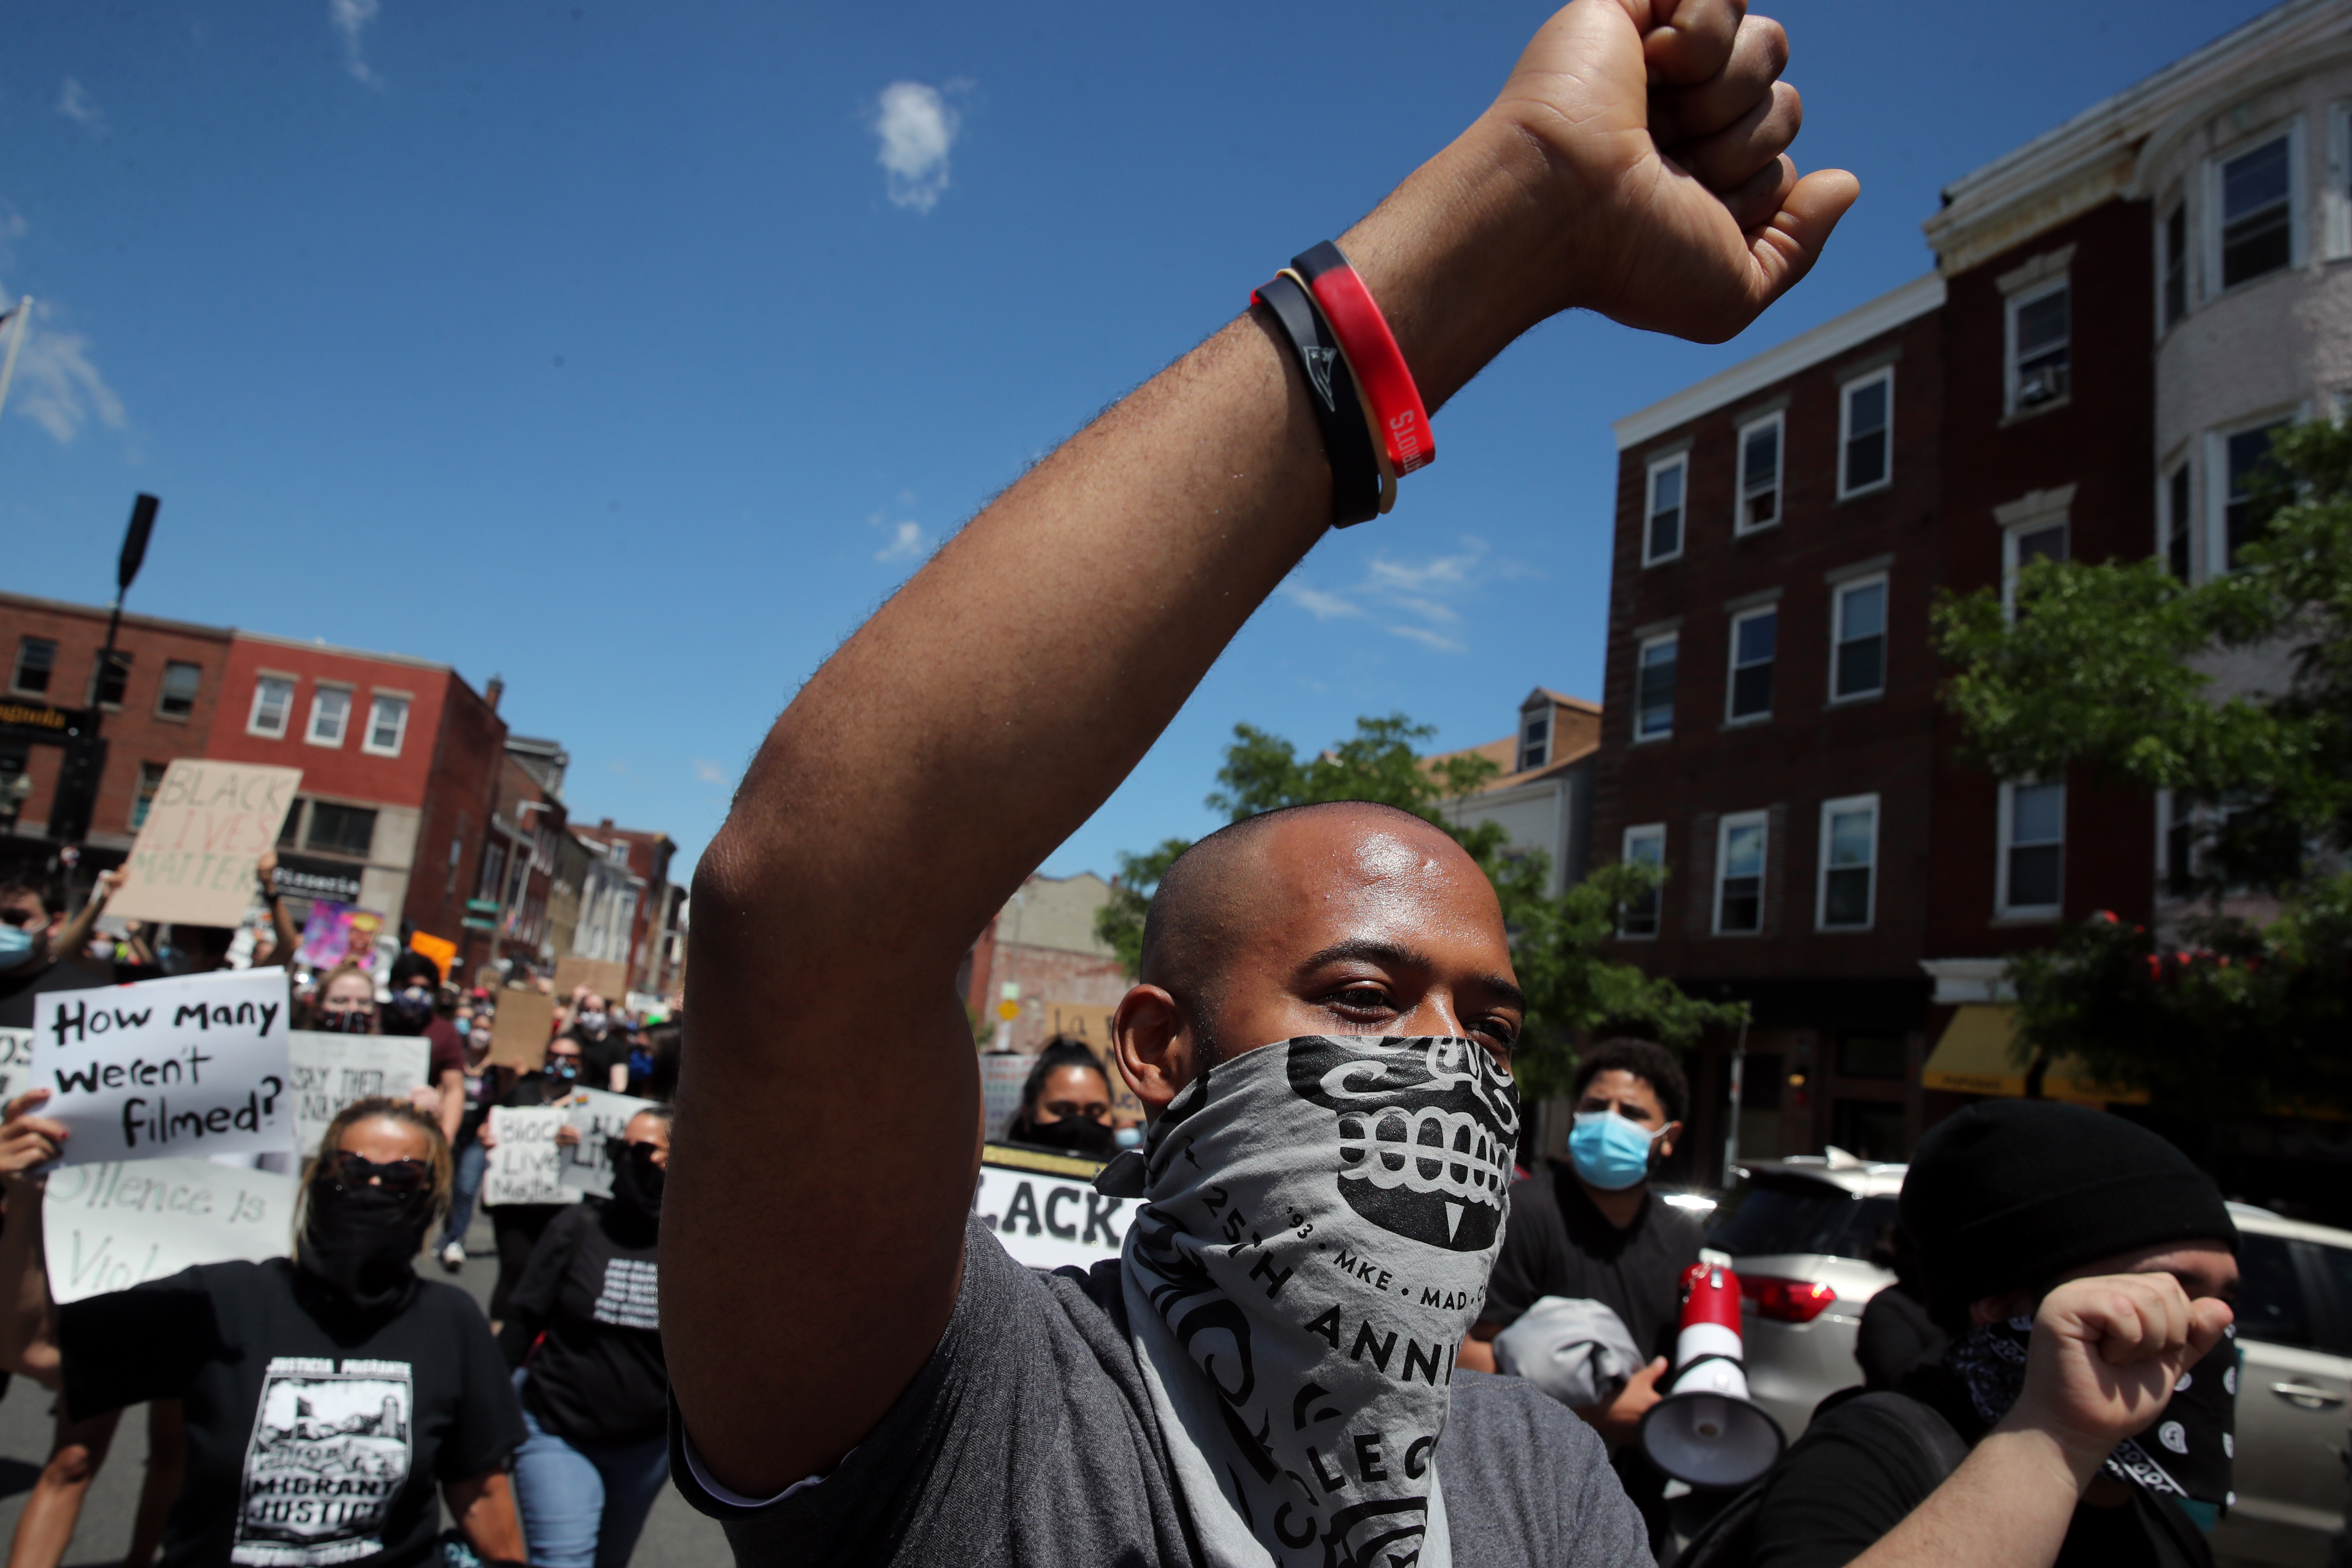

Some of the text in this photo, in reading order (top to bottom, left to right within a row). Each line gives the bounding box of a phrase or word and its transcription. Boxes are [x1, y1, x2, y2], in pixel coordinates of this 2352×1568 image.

[159, 762, 293, 814] BLACK
[139, 808, 279, 852] LIVES
[131, 851, 258, 893] MATTER
[51, 1000, 153, 1047] How
[123, 1075, 283, 1147] filmed?
[499, 1114, 560, 1144] Blac
[502, 1147, 560, 1176] Live
[969, 1174, 1123, 1249] LACK
[70, 1229, 163, 1290] Viol
[1333, 1249, 1393, 1291] MKE
[1420, 1287, 1467, 1310] MAD
[1305, 1305, 1461, 1387] ANNI
[253, 1476, 393, 1496] MIGRANT
